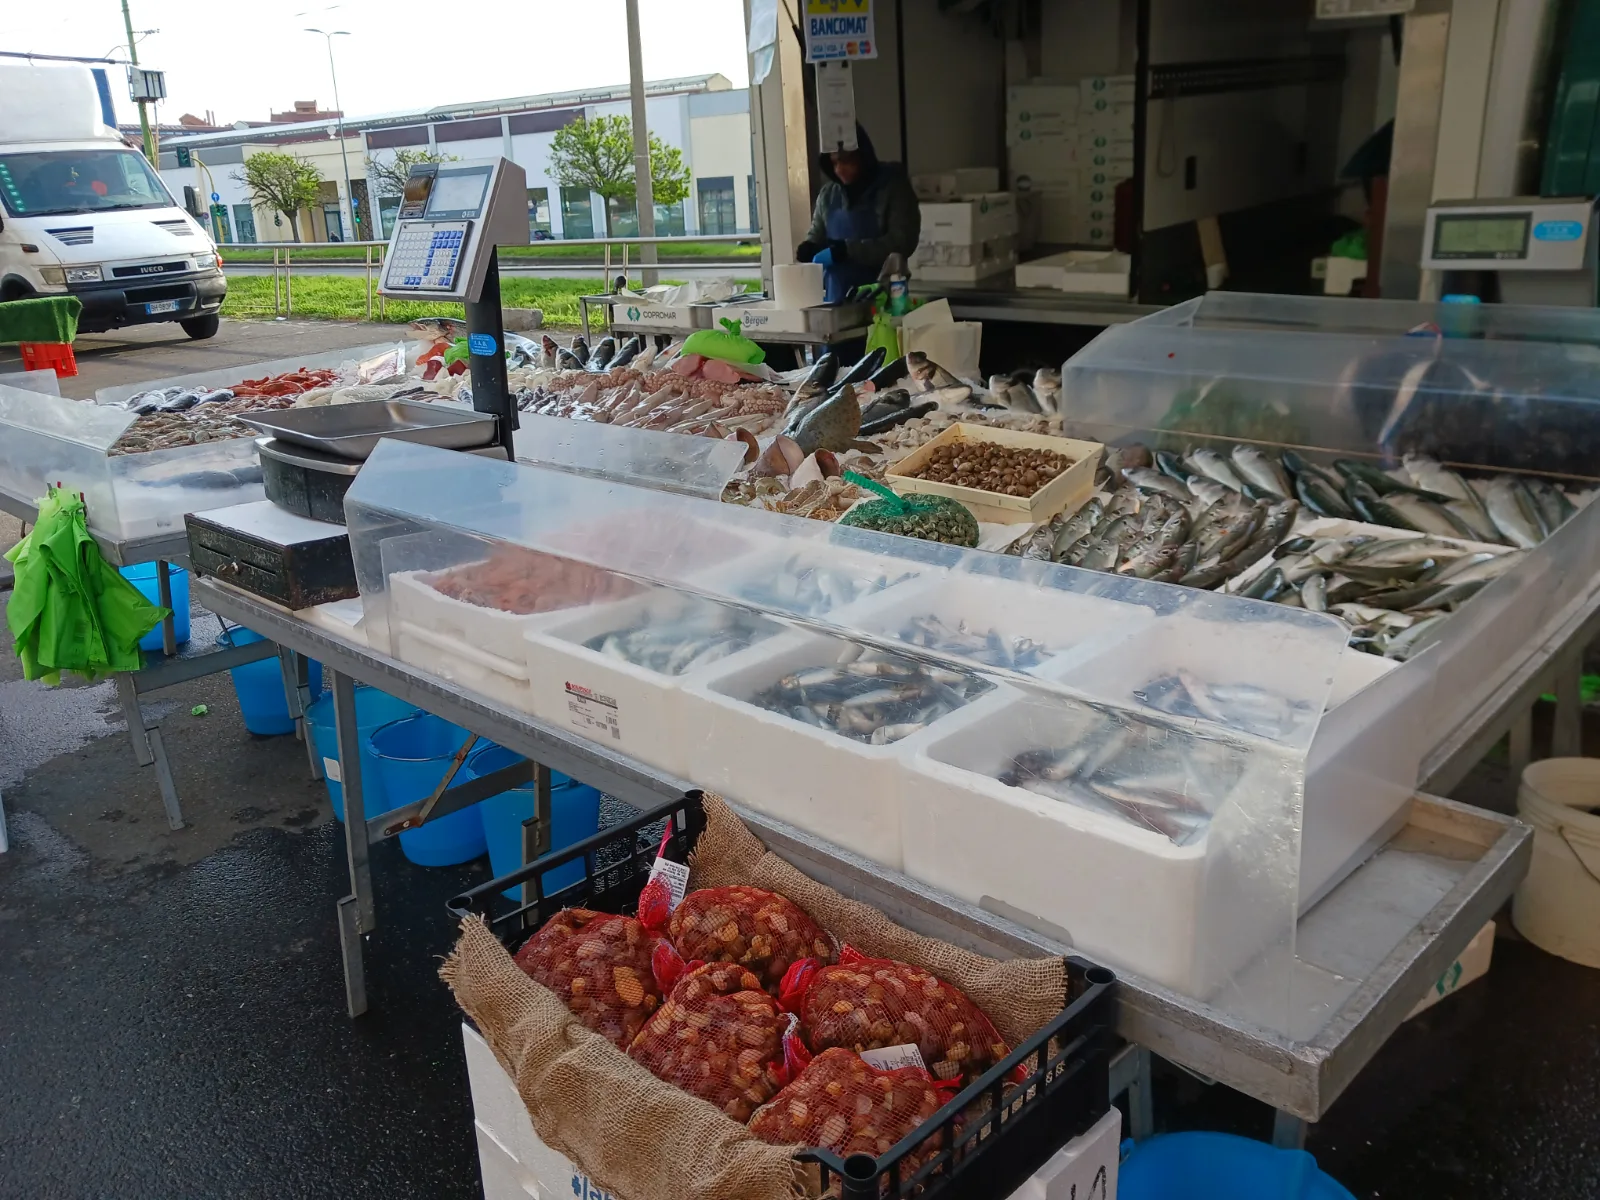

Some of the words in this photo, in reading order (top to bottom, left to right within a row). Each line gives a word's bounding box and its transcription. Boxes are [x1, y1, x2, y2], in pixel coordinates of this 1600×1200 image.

[811, 16, 868, 36] BANCOMAT
[140, 265, 164, 273] IVECO
[643, 311, 677, 320] COPROMAR
